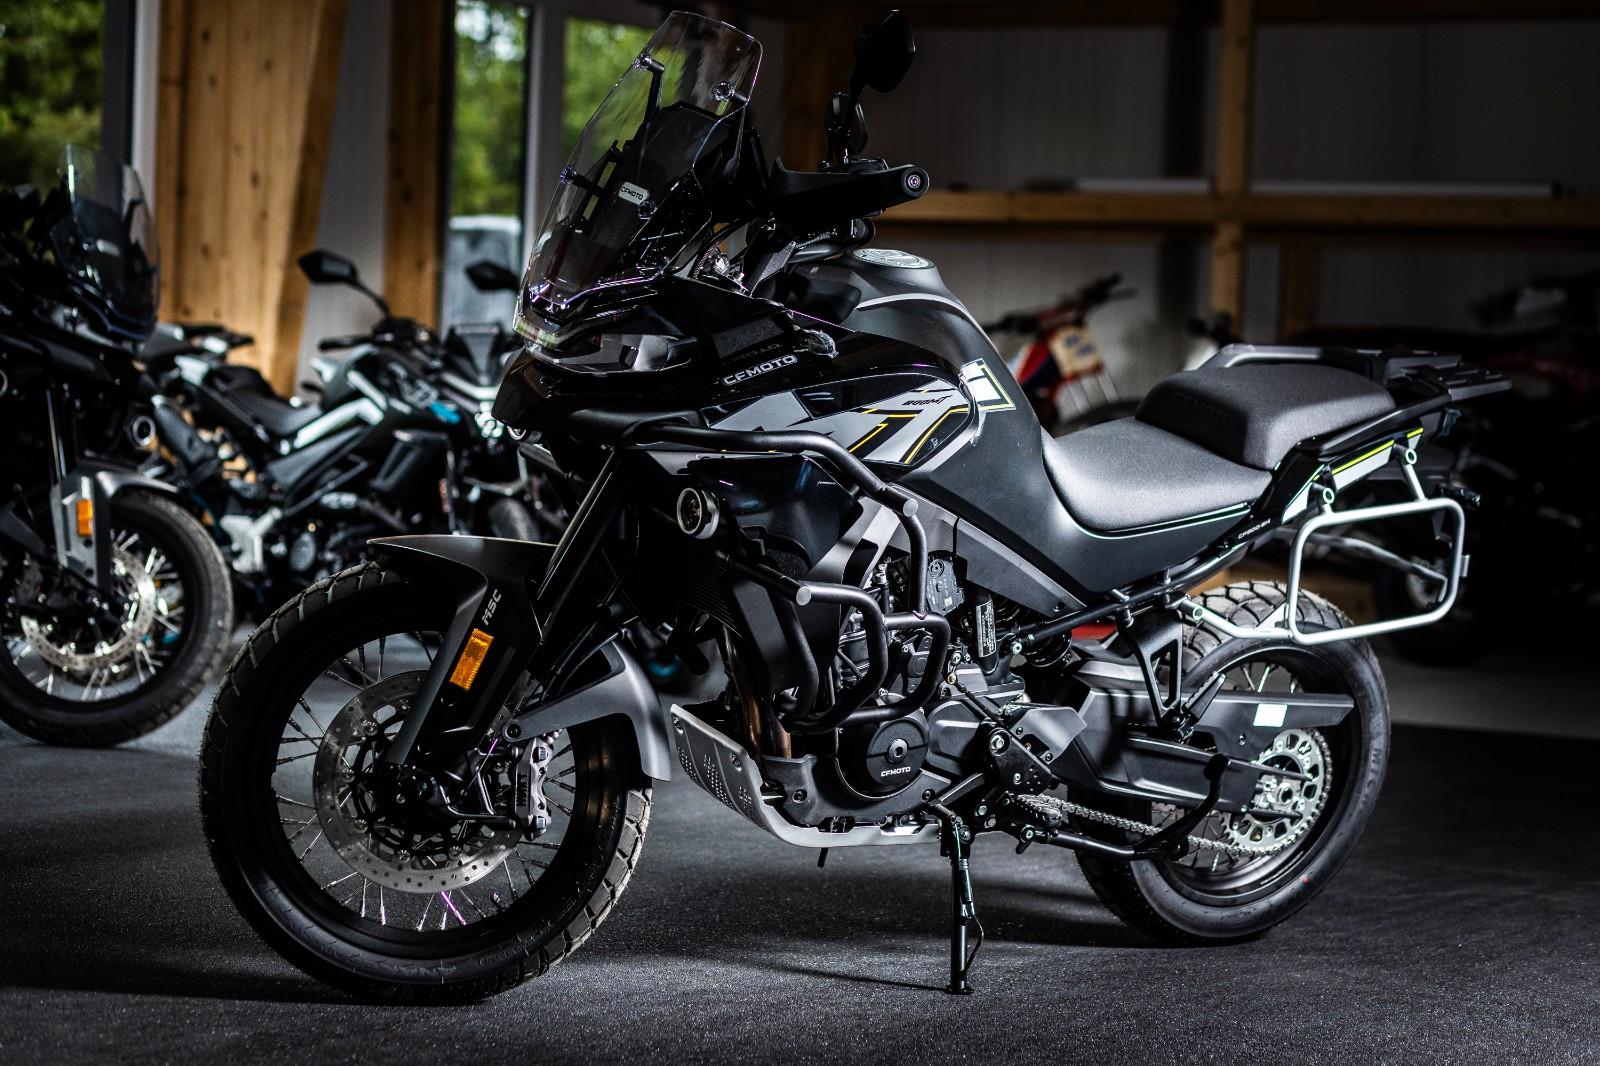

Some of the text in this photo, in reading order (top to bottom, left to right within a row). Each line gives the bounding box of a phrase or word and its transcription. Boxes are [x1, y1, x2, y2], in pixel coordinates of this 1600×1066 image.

[620, 186, 644, 200] CFMOTO
[722, 354, 798, 386] CFMOTO
[481, 588, 502, 626] MSC
[881, 766, 911, 777] CFMOTO
